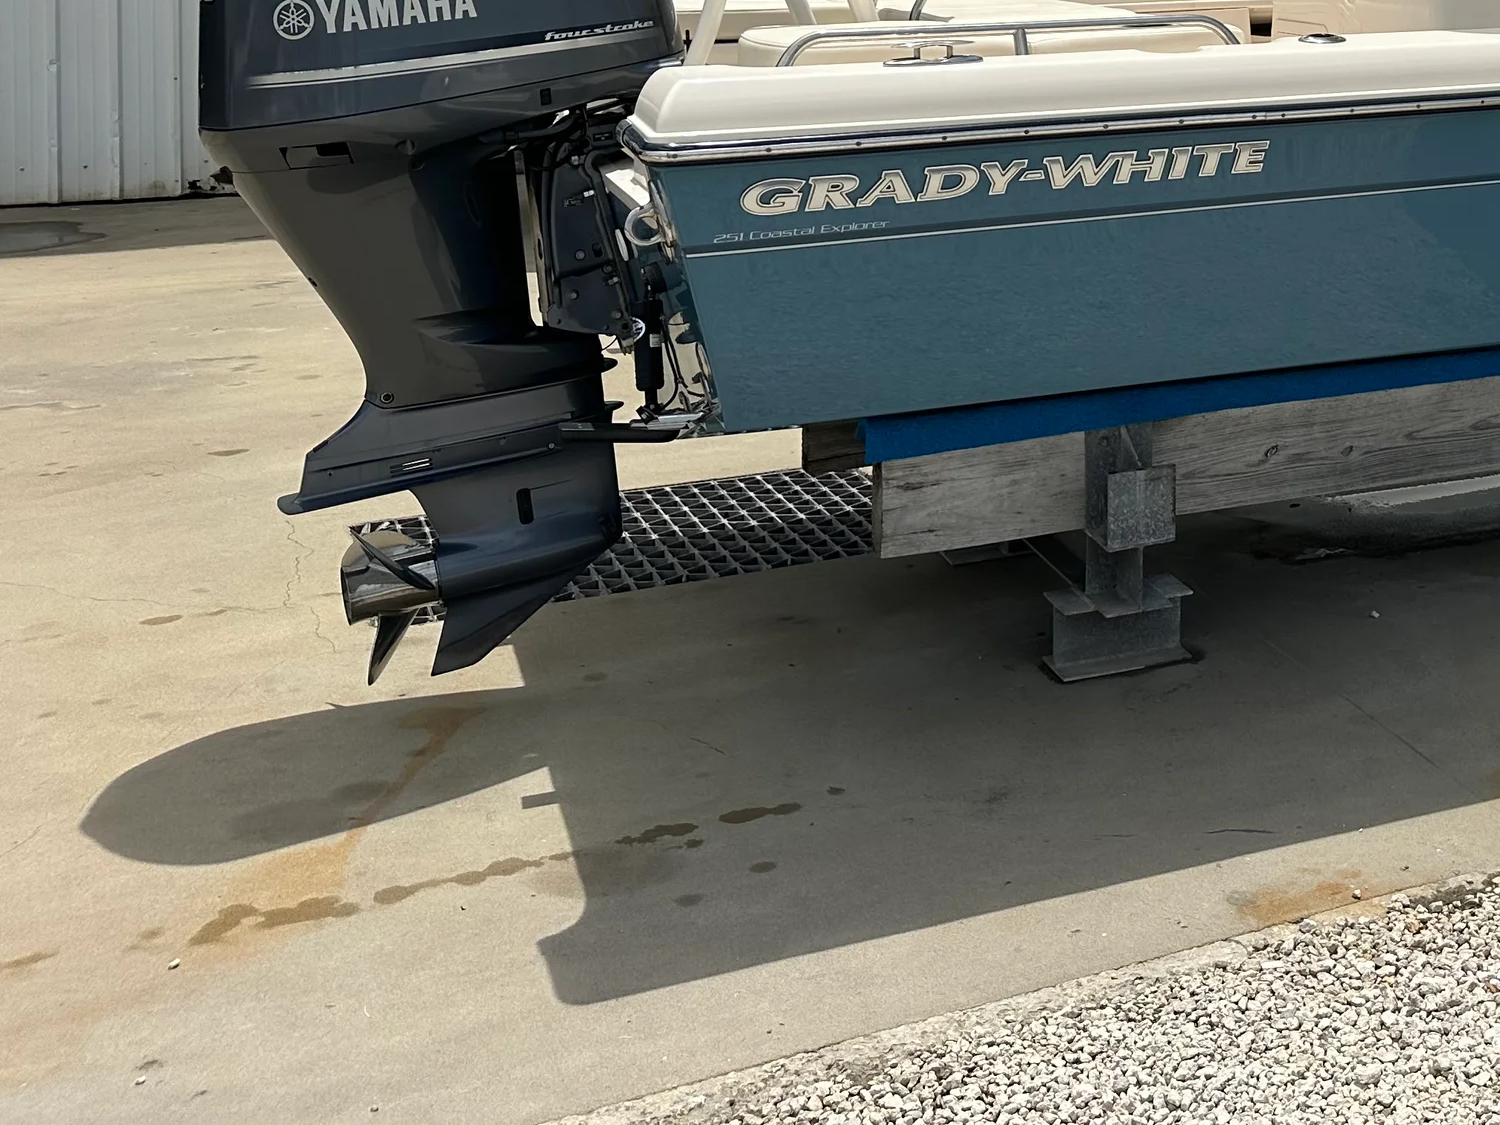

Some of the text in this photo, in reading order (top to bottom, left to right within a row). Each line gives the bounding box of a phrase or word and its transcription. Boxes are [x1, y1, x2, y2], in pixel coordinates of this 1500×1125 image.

[739, 140, 1270, 217] GRADY-WHITE
[713, 220, 891, 244] 251 Coastal Explorer
